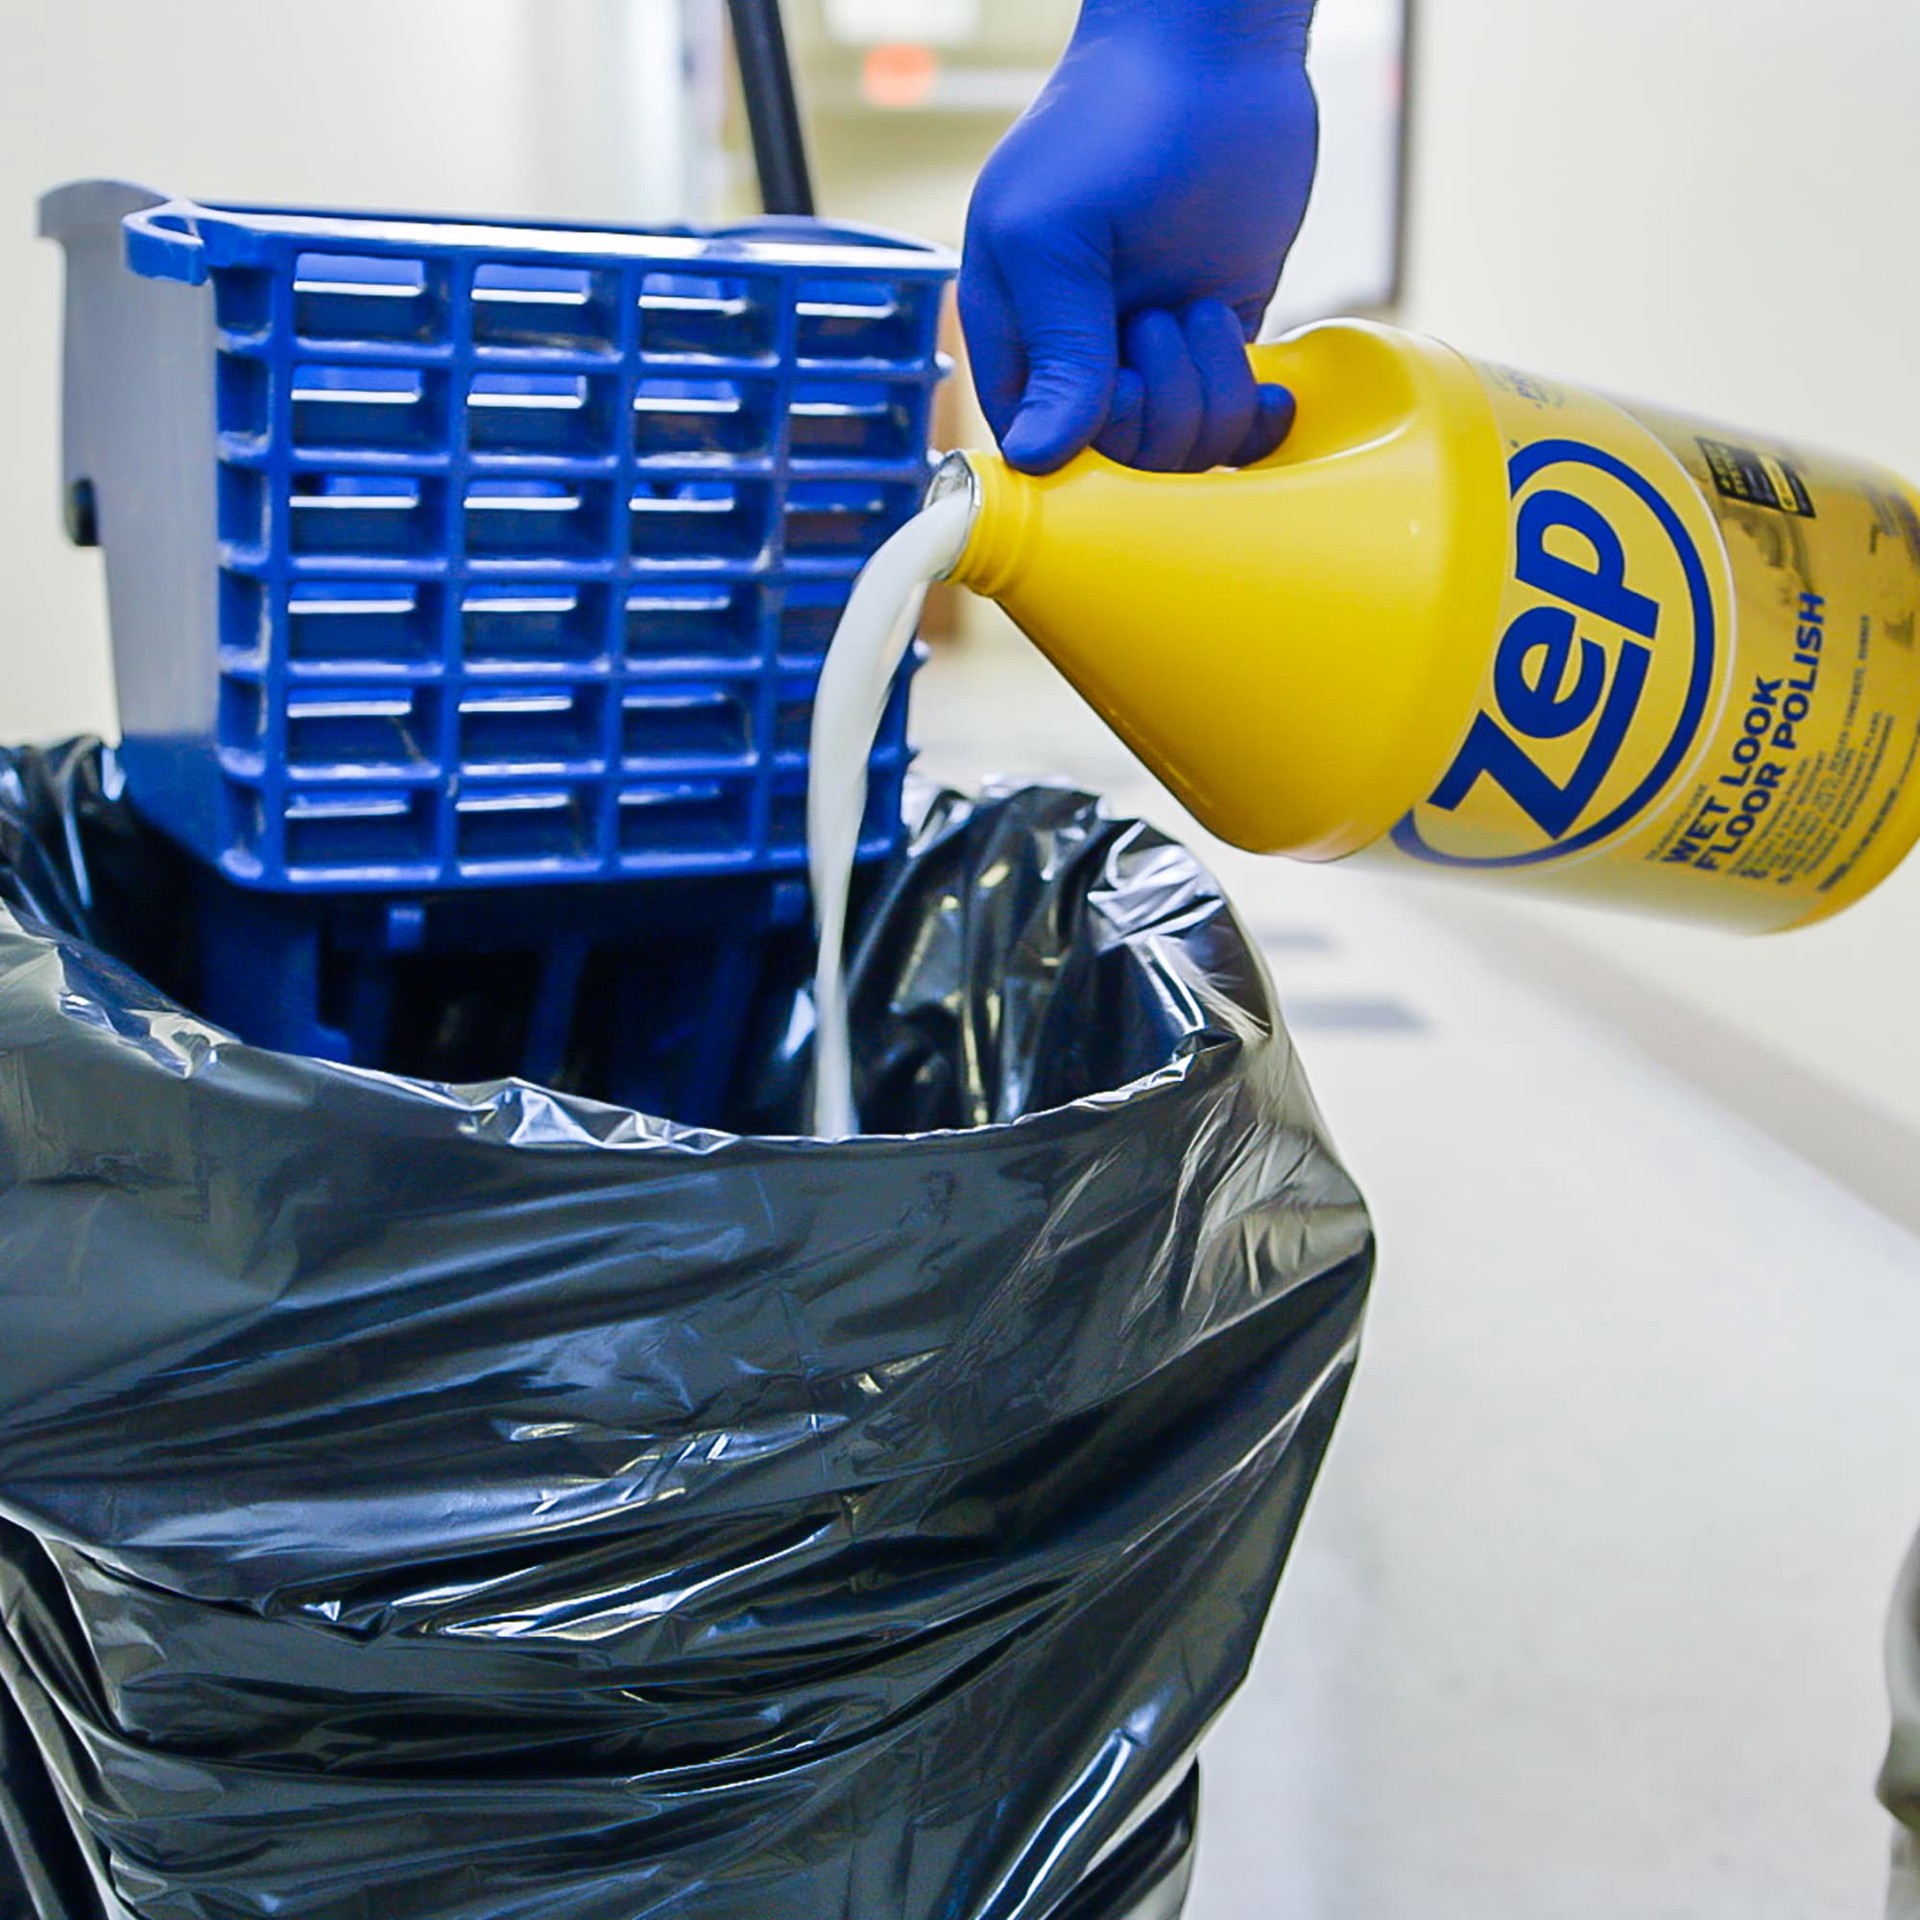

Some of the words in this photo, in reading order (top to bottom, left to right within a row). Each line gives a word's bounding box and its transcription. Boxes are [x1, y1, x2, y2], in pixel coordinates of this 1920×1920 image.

[1660, 796, 1730, 864] WET
[1720, 676, 1783, 787] LOOK
[1693, 762, 1787, 872] FLOOR
[1771, 592, 1825, 750] POLISH
